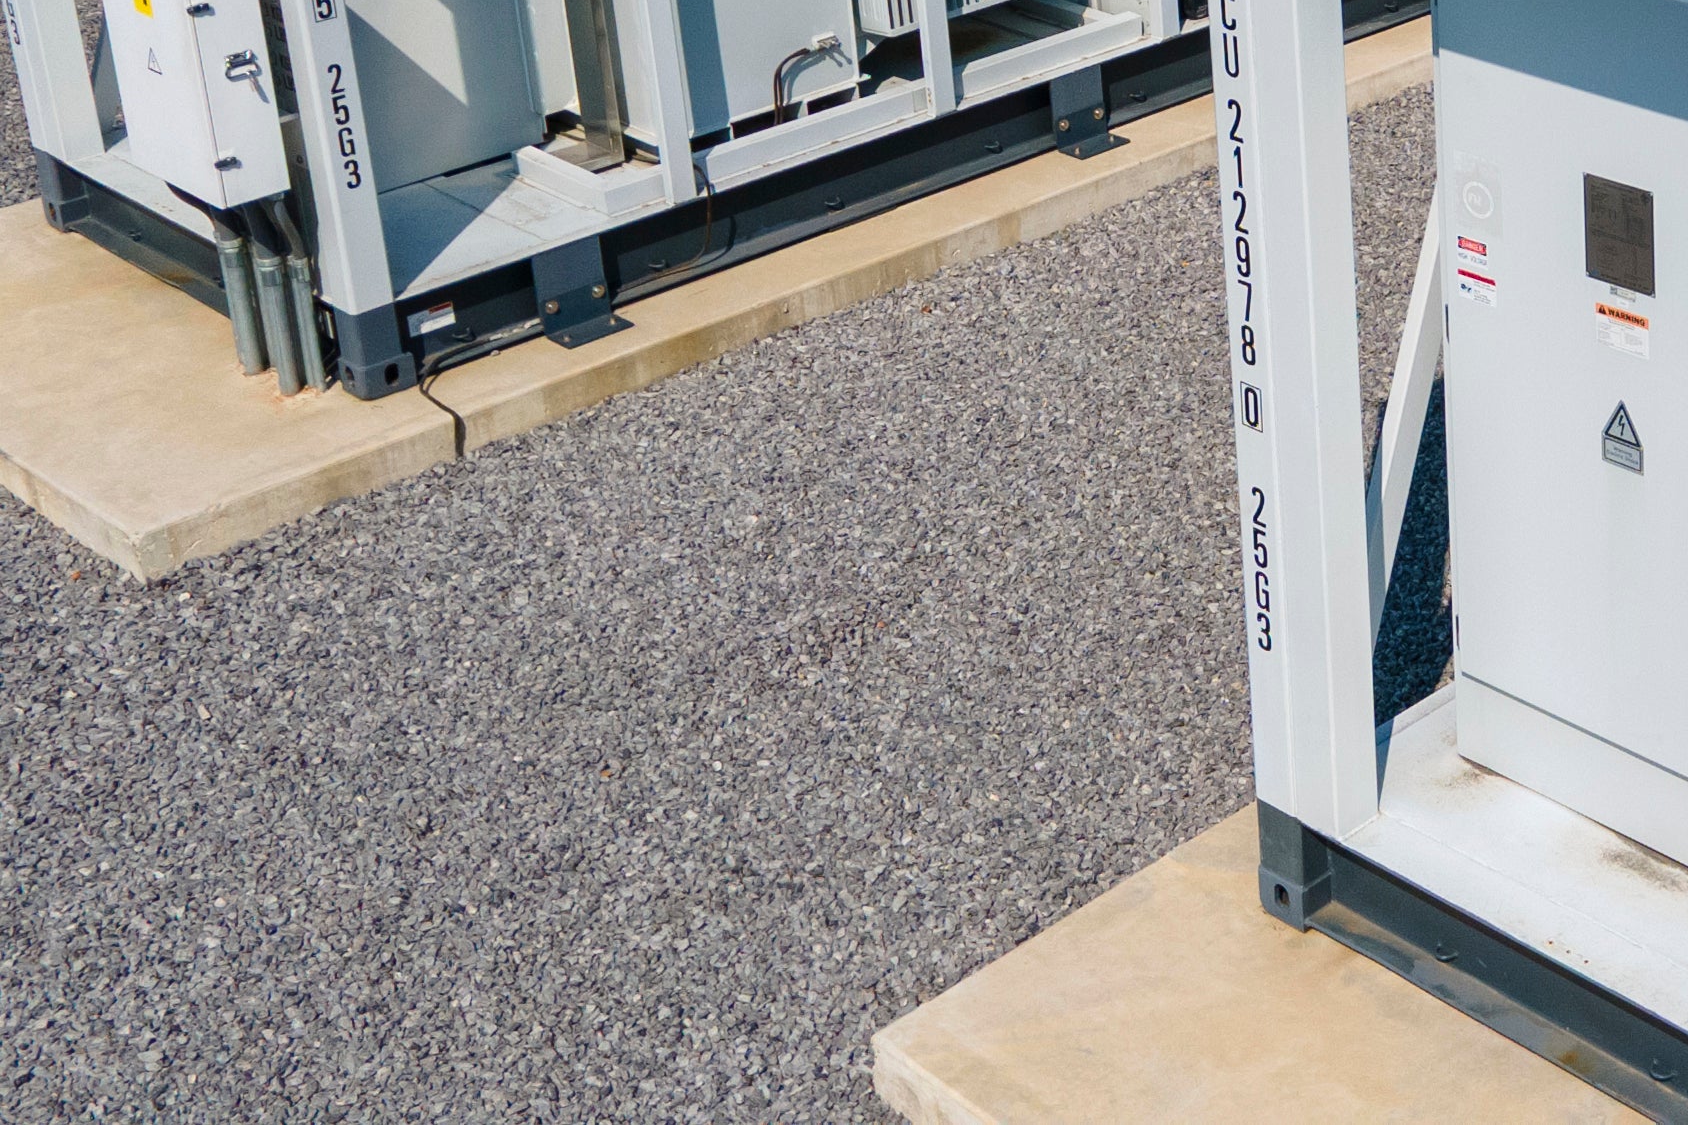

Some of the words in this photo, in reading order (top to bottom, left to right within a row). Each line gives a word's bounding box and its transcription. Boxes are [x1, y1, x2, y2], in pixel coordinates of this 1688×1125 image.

[327, 63, 362, 190] 25G3
[1227, 98, 1257, 366] 212978
[1607, 307, 1645, 327] WARNING
[1244, 386, 1259, 428] 0
[1251, 486, 1272, 652] 25G3
